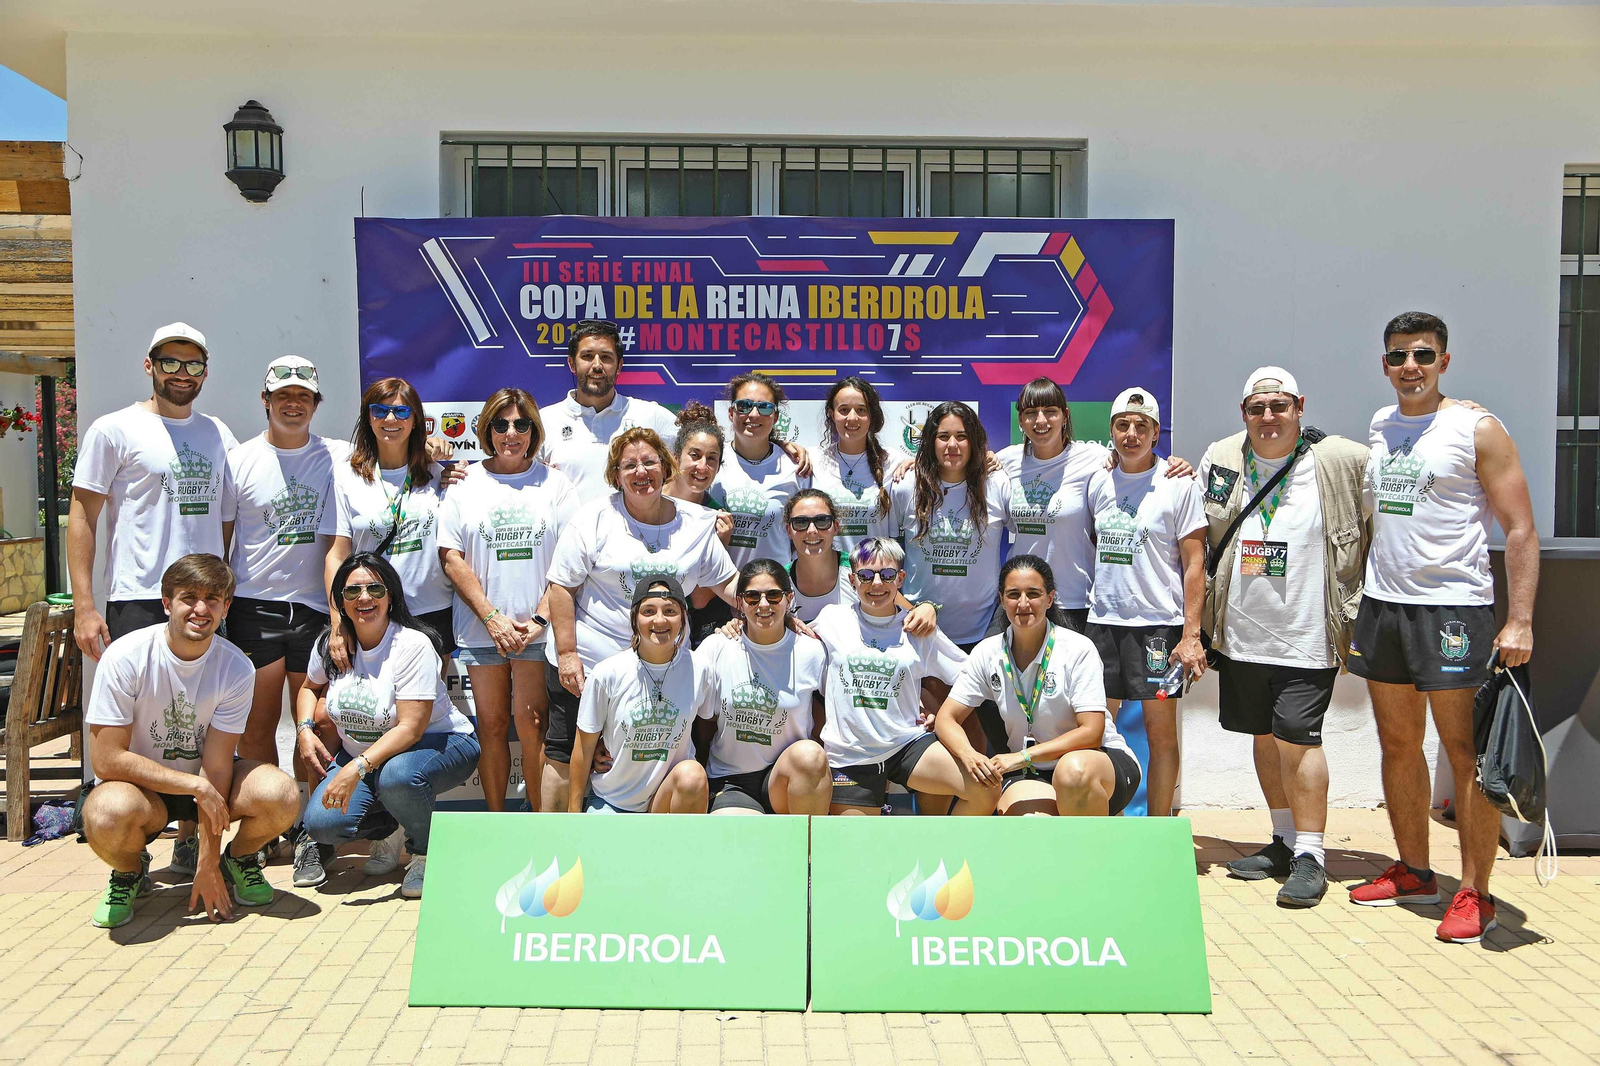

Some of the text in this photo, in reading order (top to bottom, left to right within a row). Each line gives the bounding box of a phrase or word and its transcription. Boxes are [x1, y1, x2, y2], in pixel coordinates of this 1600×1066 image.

[523, 262, 694, 282] III SERIE FINAL
[520, 284, 986, 320] COPA DE LA REINA IBERDROLA
[536, 323, 577, 344] 201
[178, 486, 202, 494] RUGBY
[1380, 482, 1415, 493] RUGBY 7
[1374, 491, 1427, 502] MONTECASTILLO
[415, 523, 419, 531] 7
[733, 520, 753, 529] UGBY
[495, 531, 532, 541] RUGBY 7
[1100, 536, 1126, 545] RUGBY
[487, 540, 542, 549] MONTECASTILLO
[1098, 545, 1142, 554] ONTECASTILLO
[1242, 546, 1286, 558] RUGBY 7
[852, 679, 881, 689] RUGBY
[844, 688, 899, 698] MONTECASTILLO
[340, 715, 368, 725] RUGBY
[735, 714, 763, 725] RUGBY
[726, 722, 781, 734] MONTECASTILLO
[166, 731, 191, 743] RGBY
[633, 732, 671, 741] RUGBY 7
[512, 932, 726, 964] IBERDROLA
[910, 936, 1128, 966] IBERDROLA
